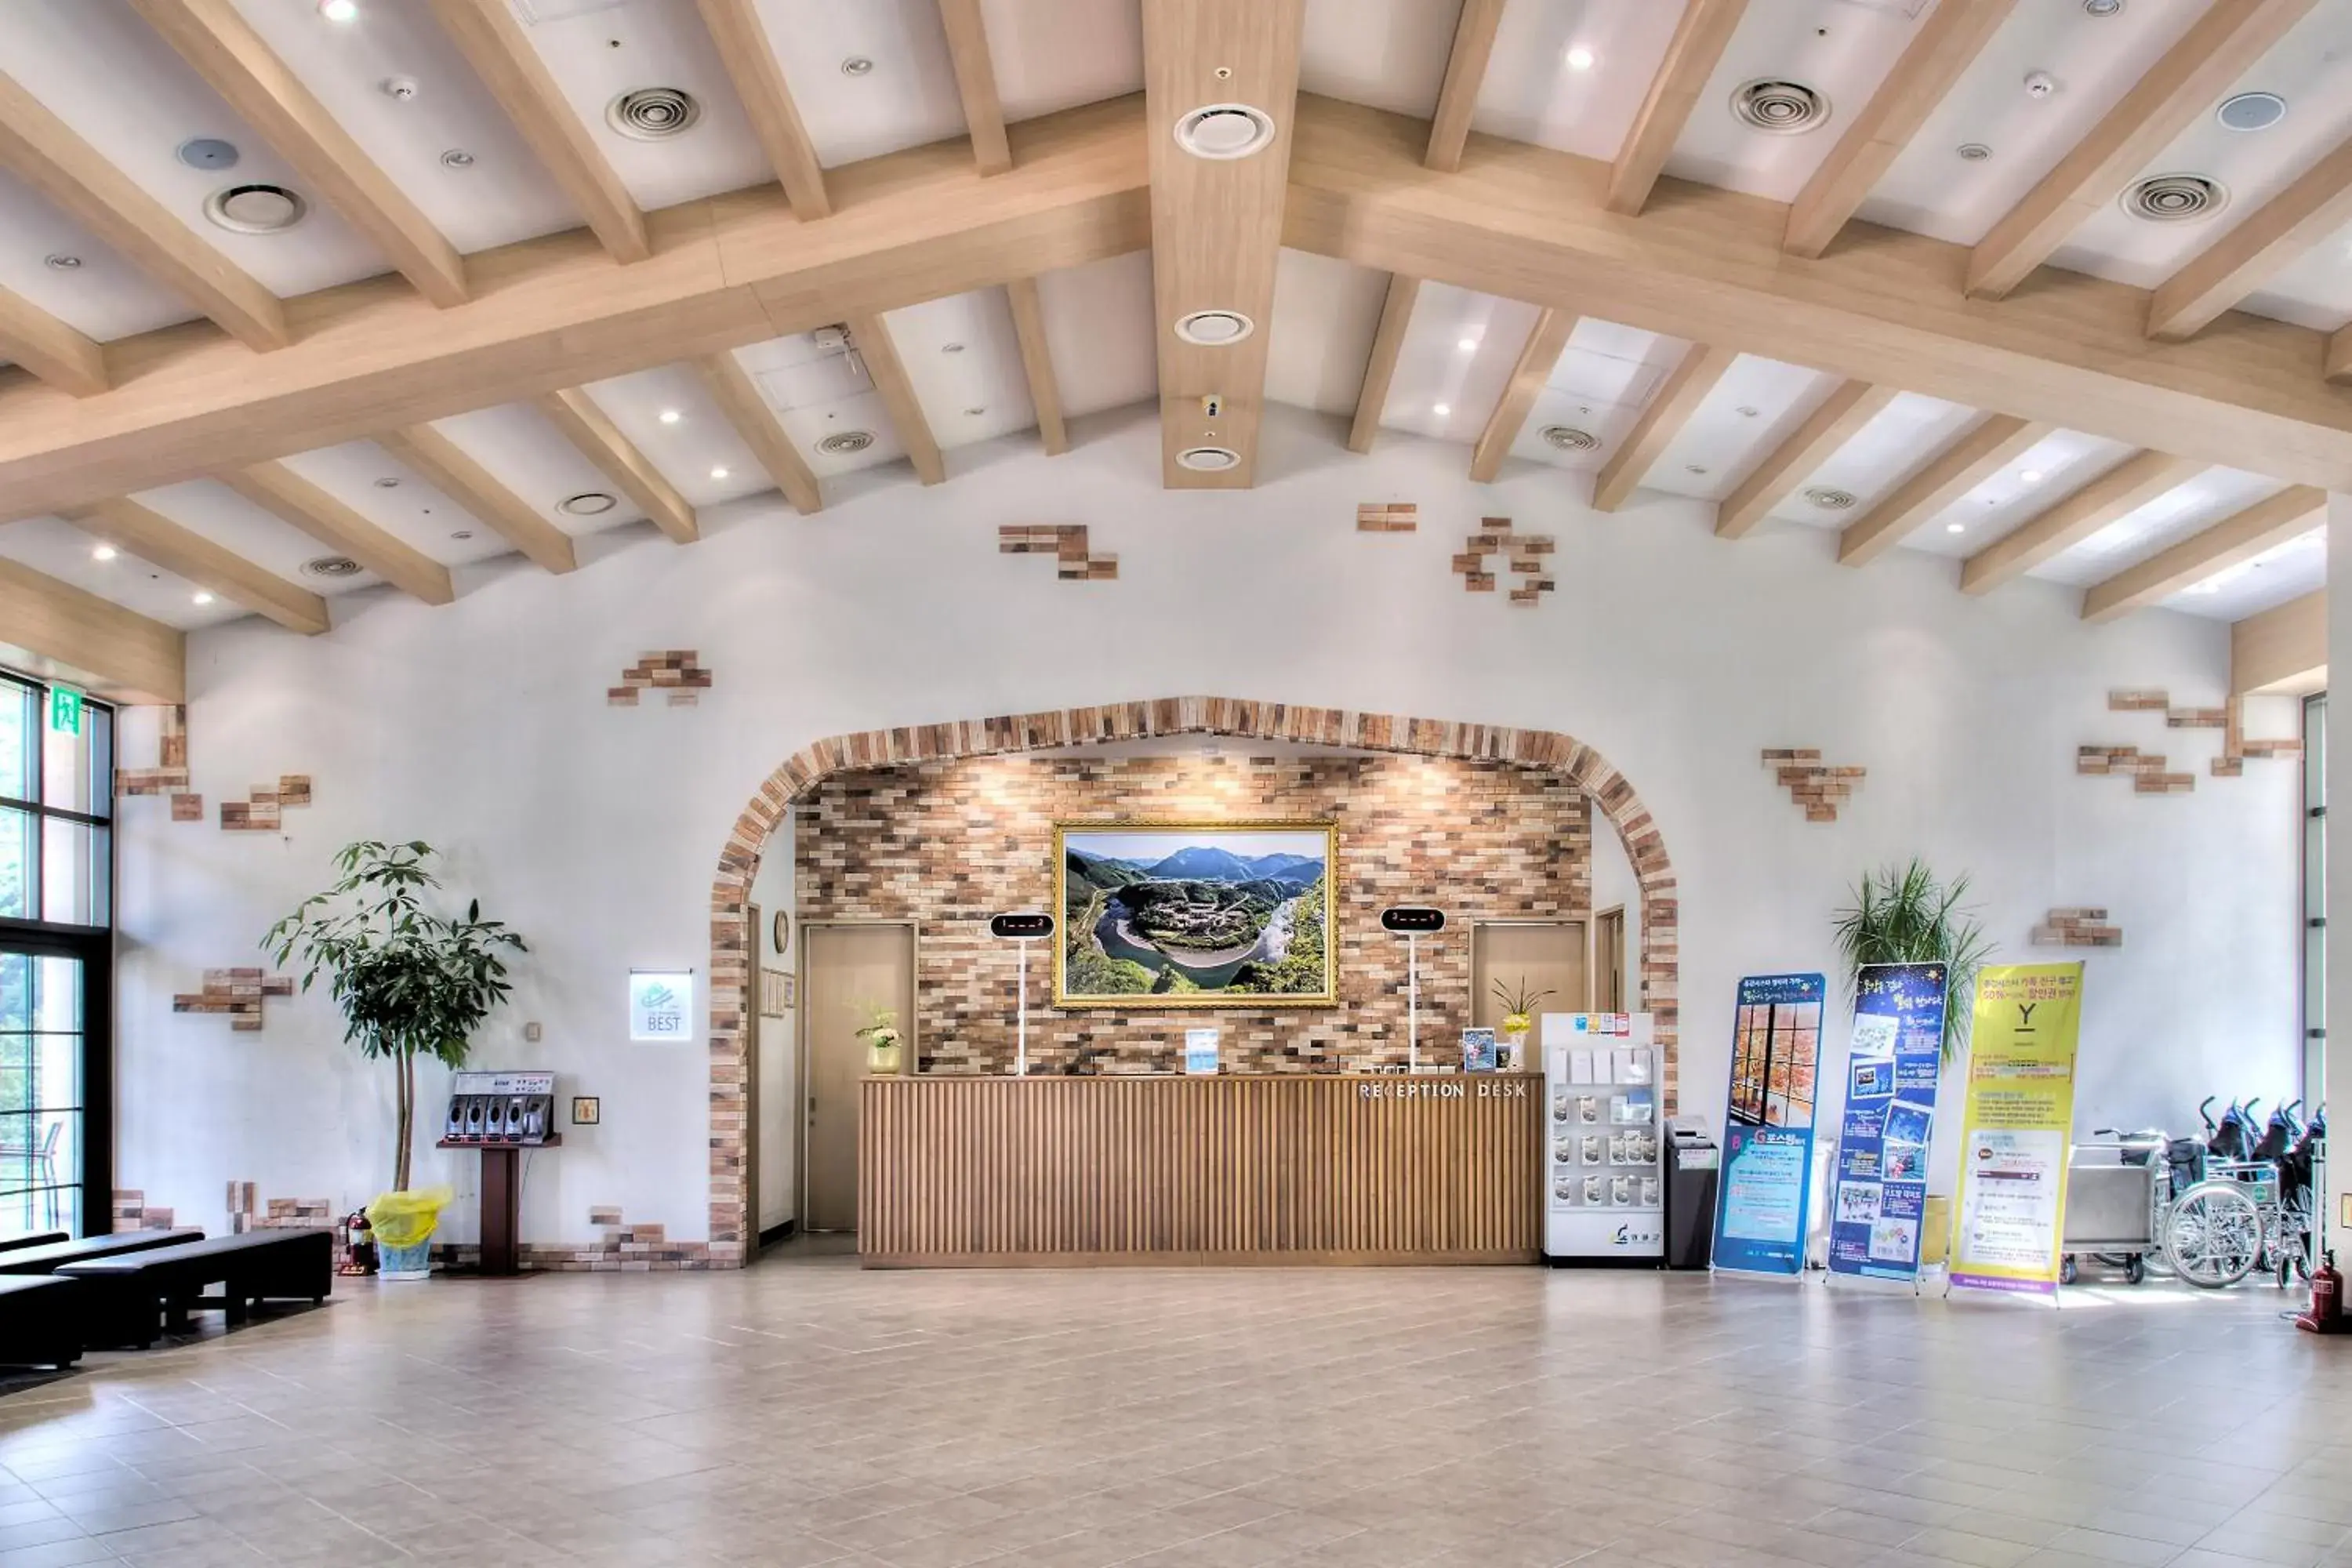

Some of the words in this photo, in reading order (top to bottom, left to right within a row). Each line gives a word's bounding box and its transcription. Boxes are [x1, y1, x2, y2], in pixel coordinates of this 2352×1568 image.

[2019, 1003, 2036, 1025] Y
[648, 1016, 681, 1031] BEST
[1359, 1083, 1465, 1098] RECEPTION
[1478, 1083, 1526, 1098] DESK
